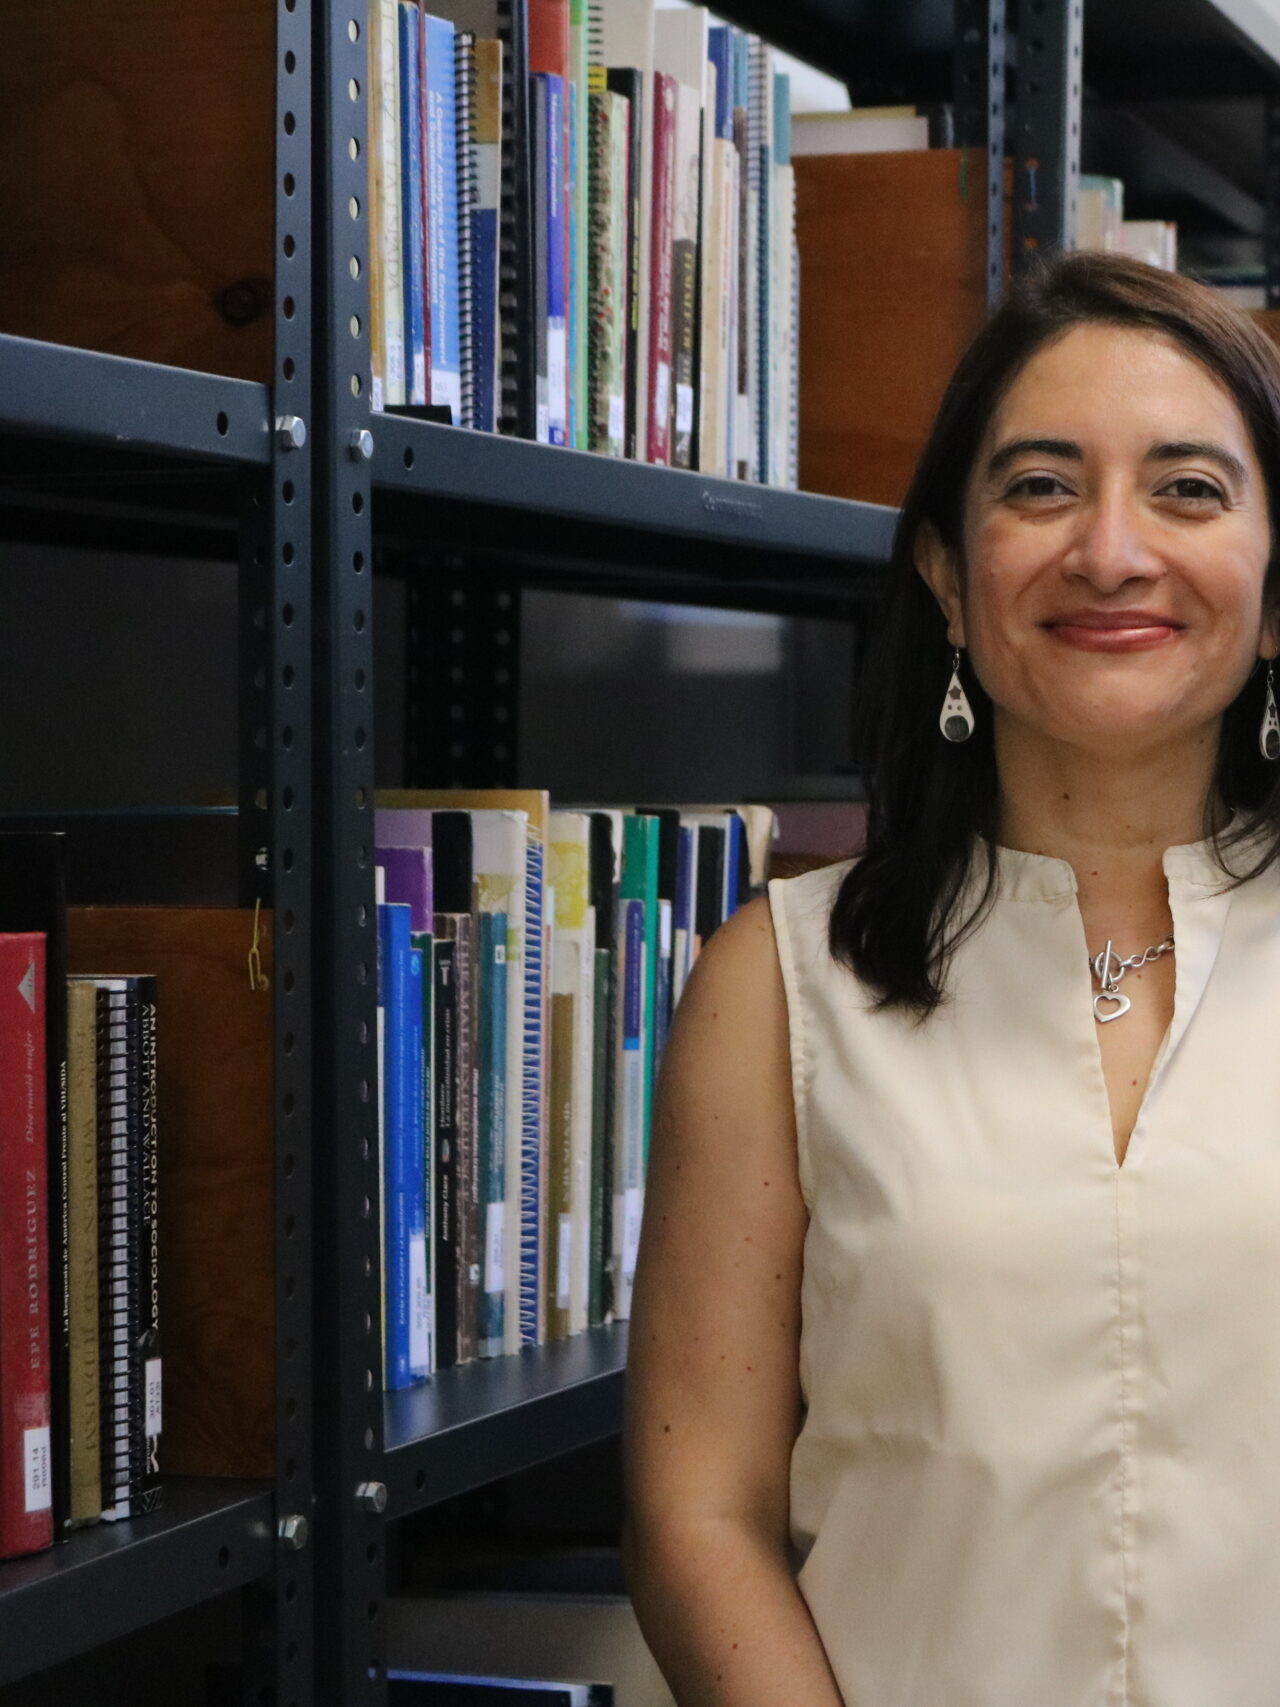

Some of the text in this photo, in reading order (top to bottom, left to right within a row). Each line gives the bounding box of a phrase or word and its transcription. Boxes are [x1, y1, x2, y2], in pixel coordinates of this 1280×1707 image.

[437, 164, 445, 225] Analysis
[430, 209, 438, 304] Development
[439, 272, 447, 365] Environment
[25, 1032, 35, 1072] mujer
[142, 1003, 150, 1079] ABBOTT
[461, 991, 470, 1052] MALE
[25, 1113, 34, 1145] Dios
[149, 1003, 159, 1331] AN INTRODUCTION TO SOCIOLOGY
[461, 1063, 470, 1202] EXPERIENCE
[143, 1132, 151, 1227] WALLACE
[442, 1201, 450, 1242] Anthony
[25, 1168, 39, 1314] RODRÍGUEZ
[82, 1118, 97, 1450] WOMEN AND JUDAISM
